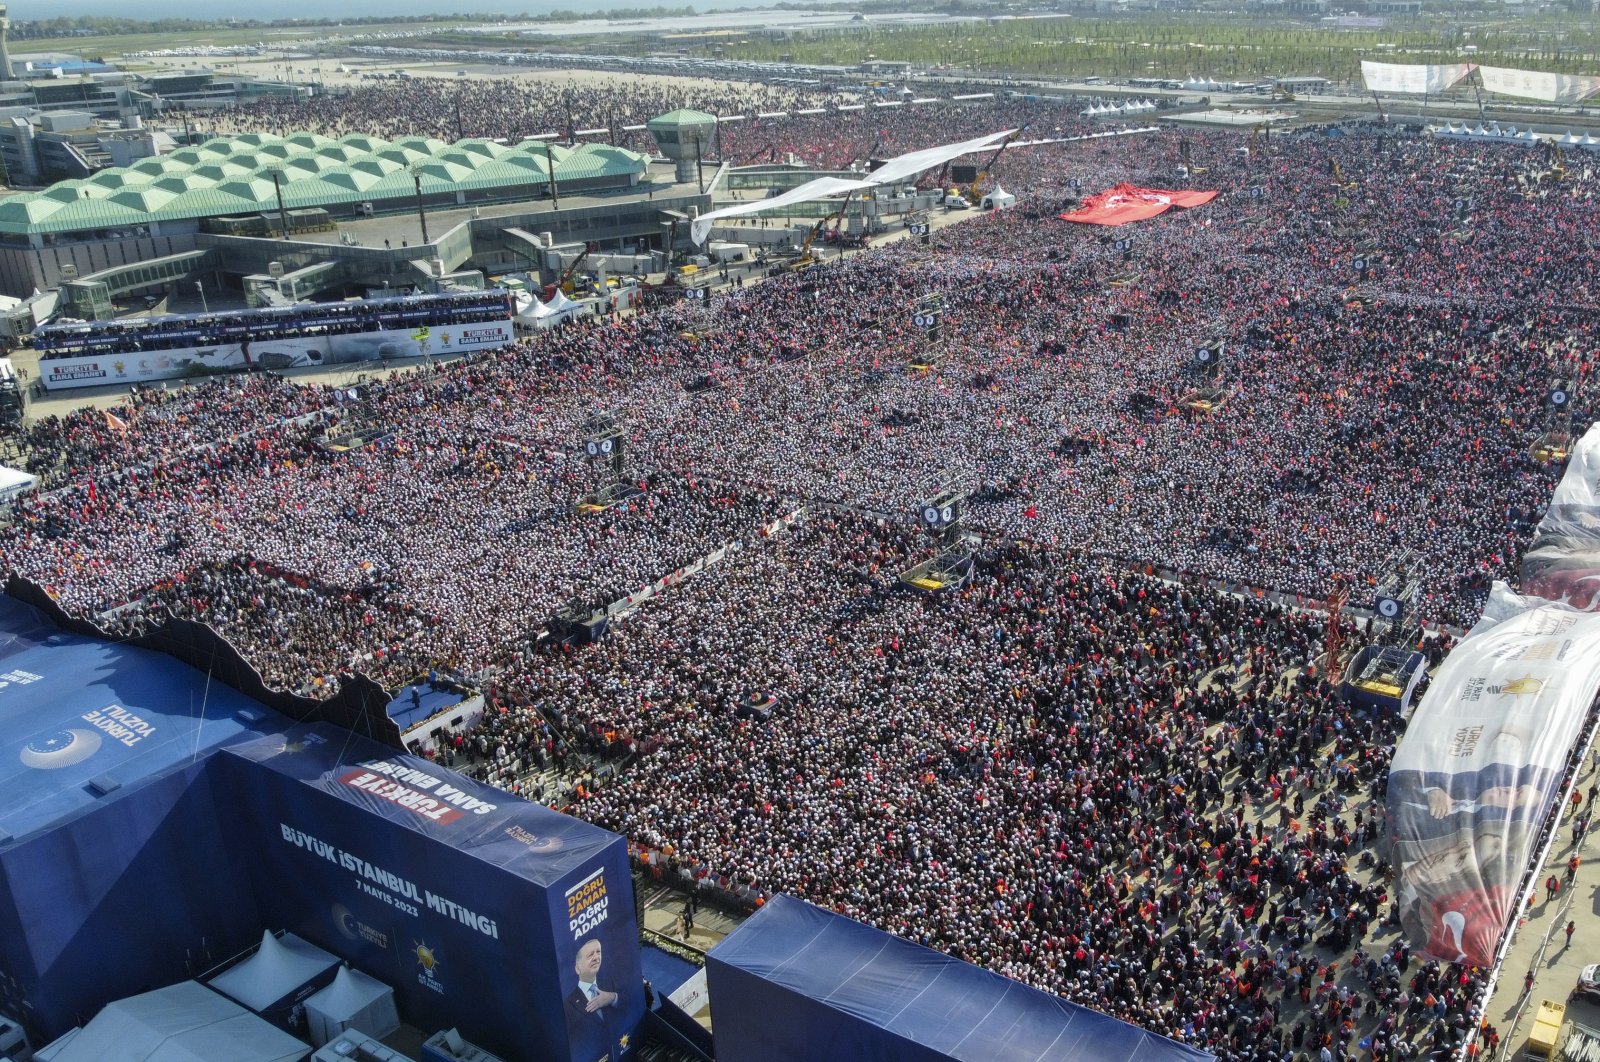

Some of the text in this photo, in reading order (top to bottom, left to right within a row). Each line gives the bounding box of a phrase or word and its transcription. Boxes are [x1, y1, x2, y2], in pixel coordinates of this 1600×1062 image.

[480, 334, 507, 343] EMANET
[73, 371, 104, 380] EMANET
[1385, 603, 1392, 611] 4
[348, 773, 452, 820] TÜRKİYE
[434, 783, 498, 815] SANA
[280, 823, 338, 864] BÜYÜK
[339, 850, 424, 904] İSTANBUL
[356, 880, 419, 917] 7 MAYIS 2023
[568, 876, 604, 908] DOĞRU
[569, 885, 607, 918] ZAMAN
[569, 896, 609, 931] DOĞRU
[575, 909, 608, 941] ADAM
